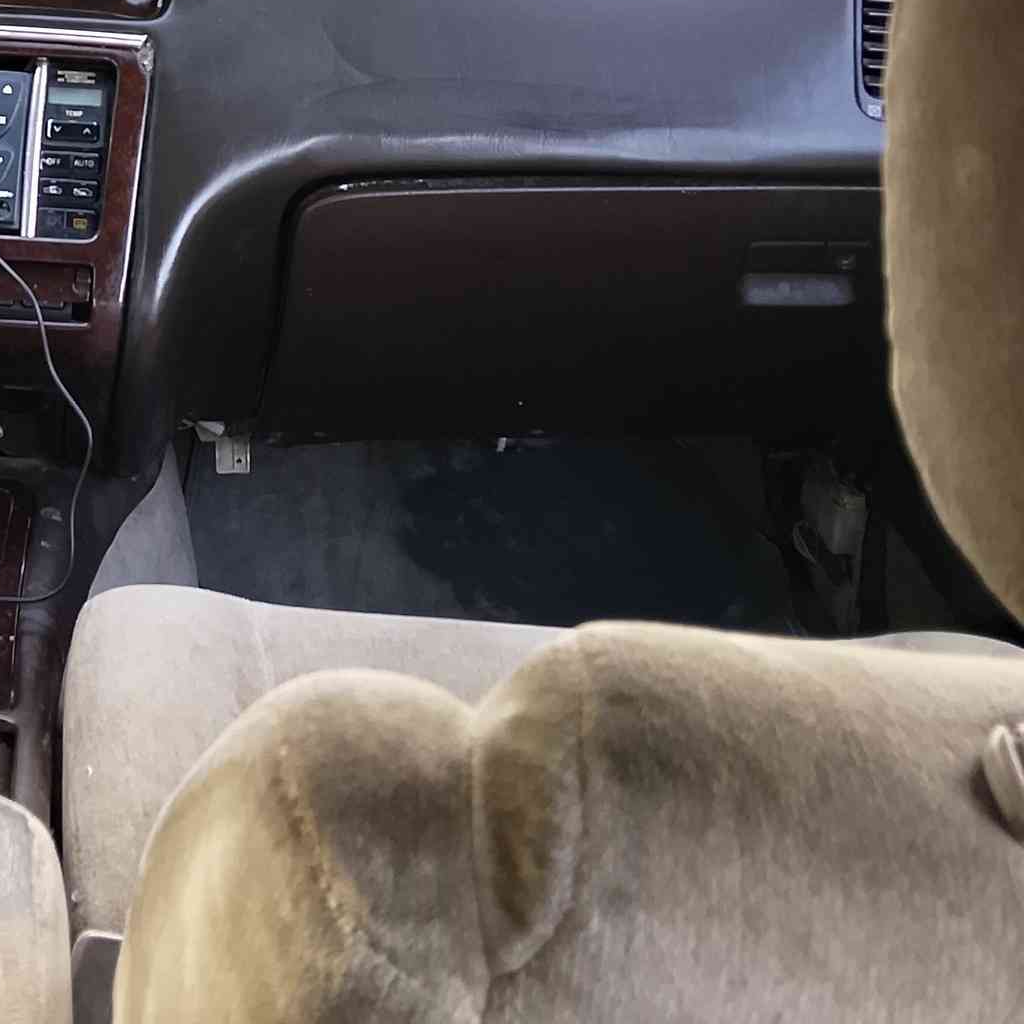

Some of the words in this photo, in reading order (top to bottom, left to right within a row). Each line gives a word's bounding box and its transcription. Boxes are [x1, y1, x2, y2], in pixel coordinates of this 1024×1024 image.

[65, 109, 84, 118] TEMP
[47, 157, 62, 166] OFF
[73, 158, 95, 168] AUTO
